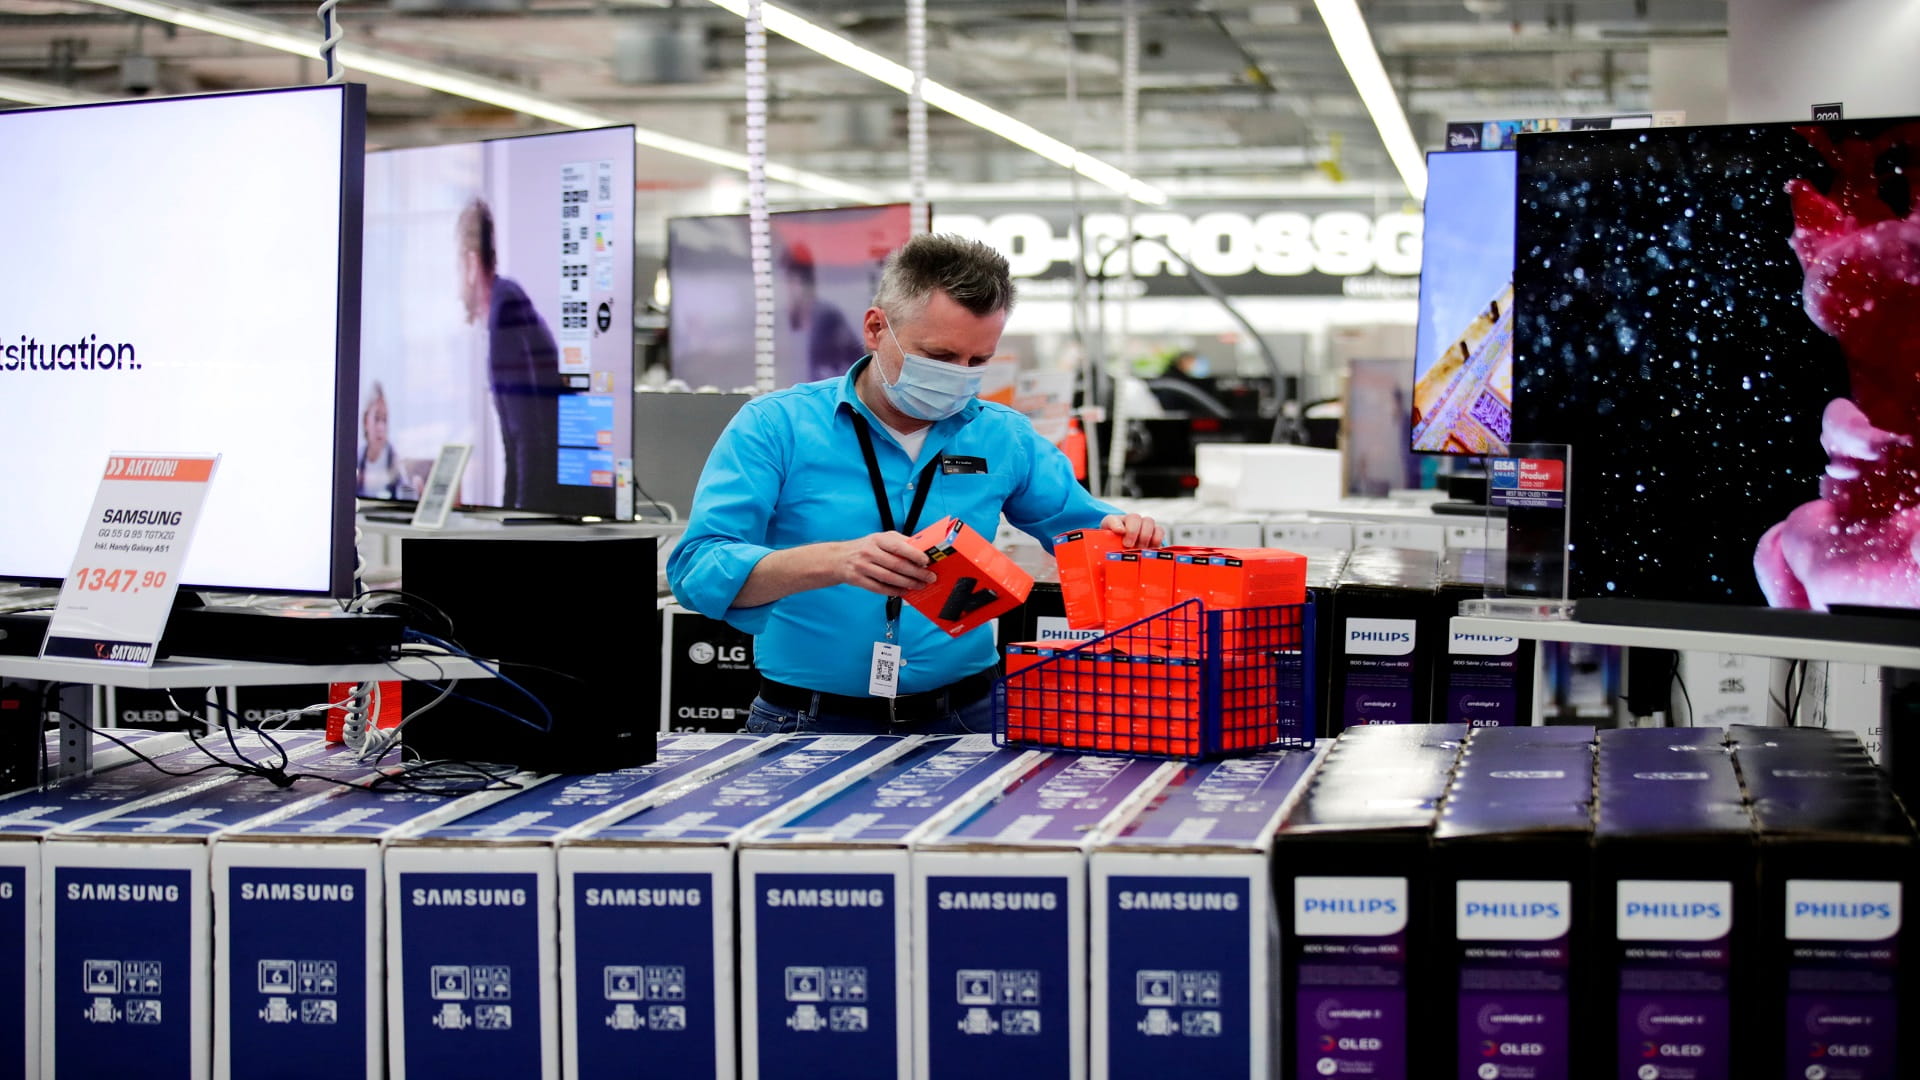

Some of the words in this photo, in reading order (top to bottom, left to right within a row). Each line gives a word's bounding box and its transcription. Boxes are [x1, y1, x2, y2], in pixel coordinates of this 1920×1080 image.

[1816, 112, 1839, 120] 2020
[125, 460, 179, 477] AKTION!
[1520, 462, 1537, 470] Best
[1520, 471, 1549, 481] Product
[102, 508, 182, 526] SAMSUNG
[111, 529, 122, 538] 55
[131, 530, 142, 539] 95
[109, 543, 130, 552] Handy
[131, 544, 153, 553] Galaxy
[1042, 630, 1100, 641] PHILIPS
[1351, 631, 1410, 642] PHILIPS
[110, 645, 150, 662] SATURN
[718, 646, 746, 661] LG
[123, 710, 164, 722] OLED
[678, 707, 719, 718] OLED
[0, 883, 12, 898] G
[67, 883, 179, 902] SAMSUNG
[241, 883, 354, 901] SAMSUNG
[412, 888, 526, 906] SAMSUNG
[586, 888, 701, 906] SAMSUNG
[767, 888, 883, 907] SAMSUNG
[938, 891, 1057, 910] SAMSUNG
[1119, 891, 1238, 911] SAMSUNG
[1304, 899, 1397, 913] PHILIPS
[1466, 903, 1560, 917] PHILIPS
[1626, 903, 1721, 918] PHILIPS
[1795, 902, 1891, 919] PHILIPS
[1338, 1038, 1382, 1050] OLED
[1500, 1043, 1543, 1055] OLED
[1660, 1044, 1703, 1056] OLED
[1827, 1045, 1870, 1056] OLED
